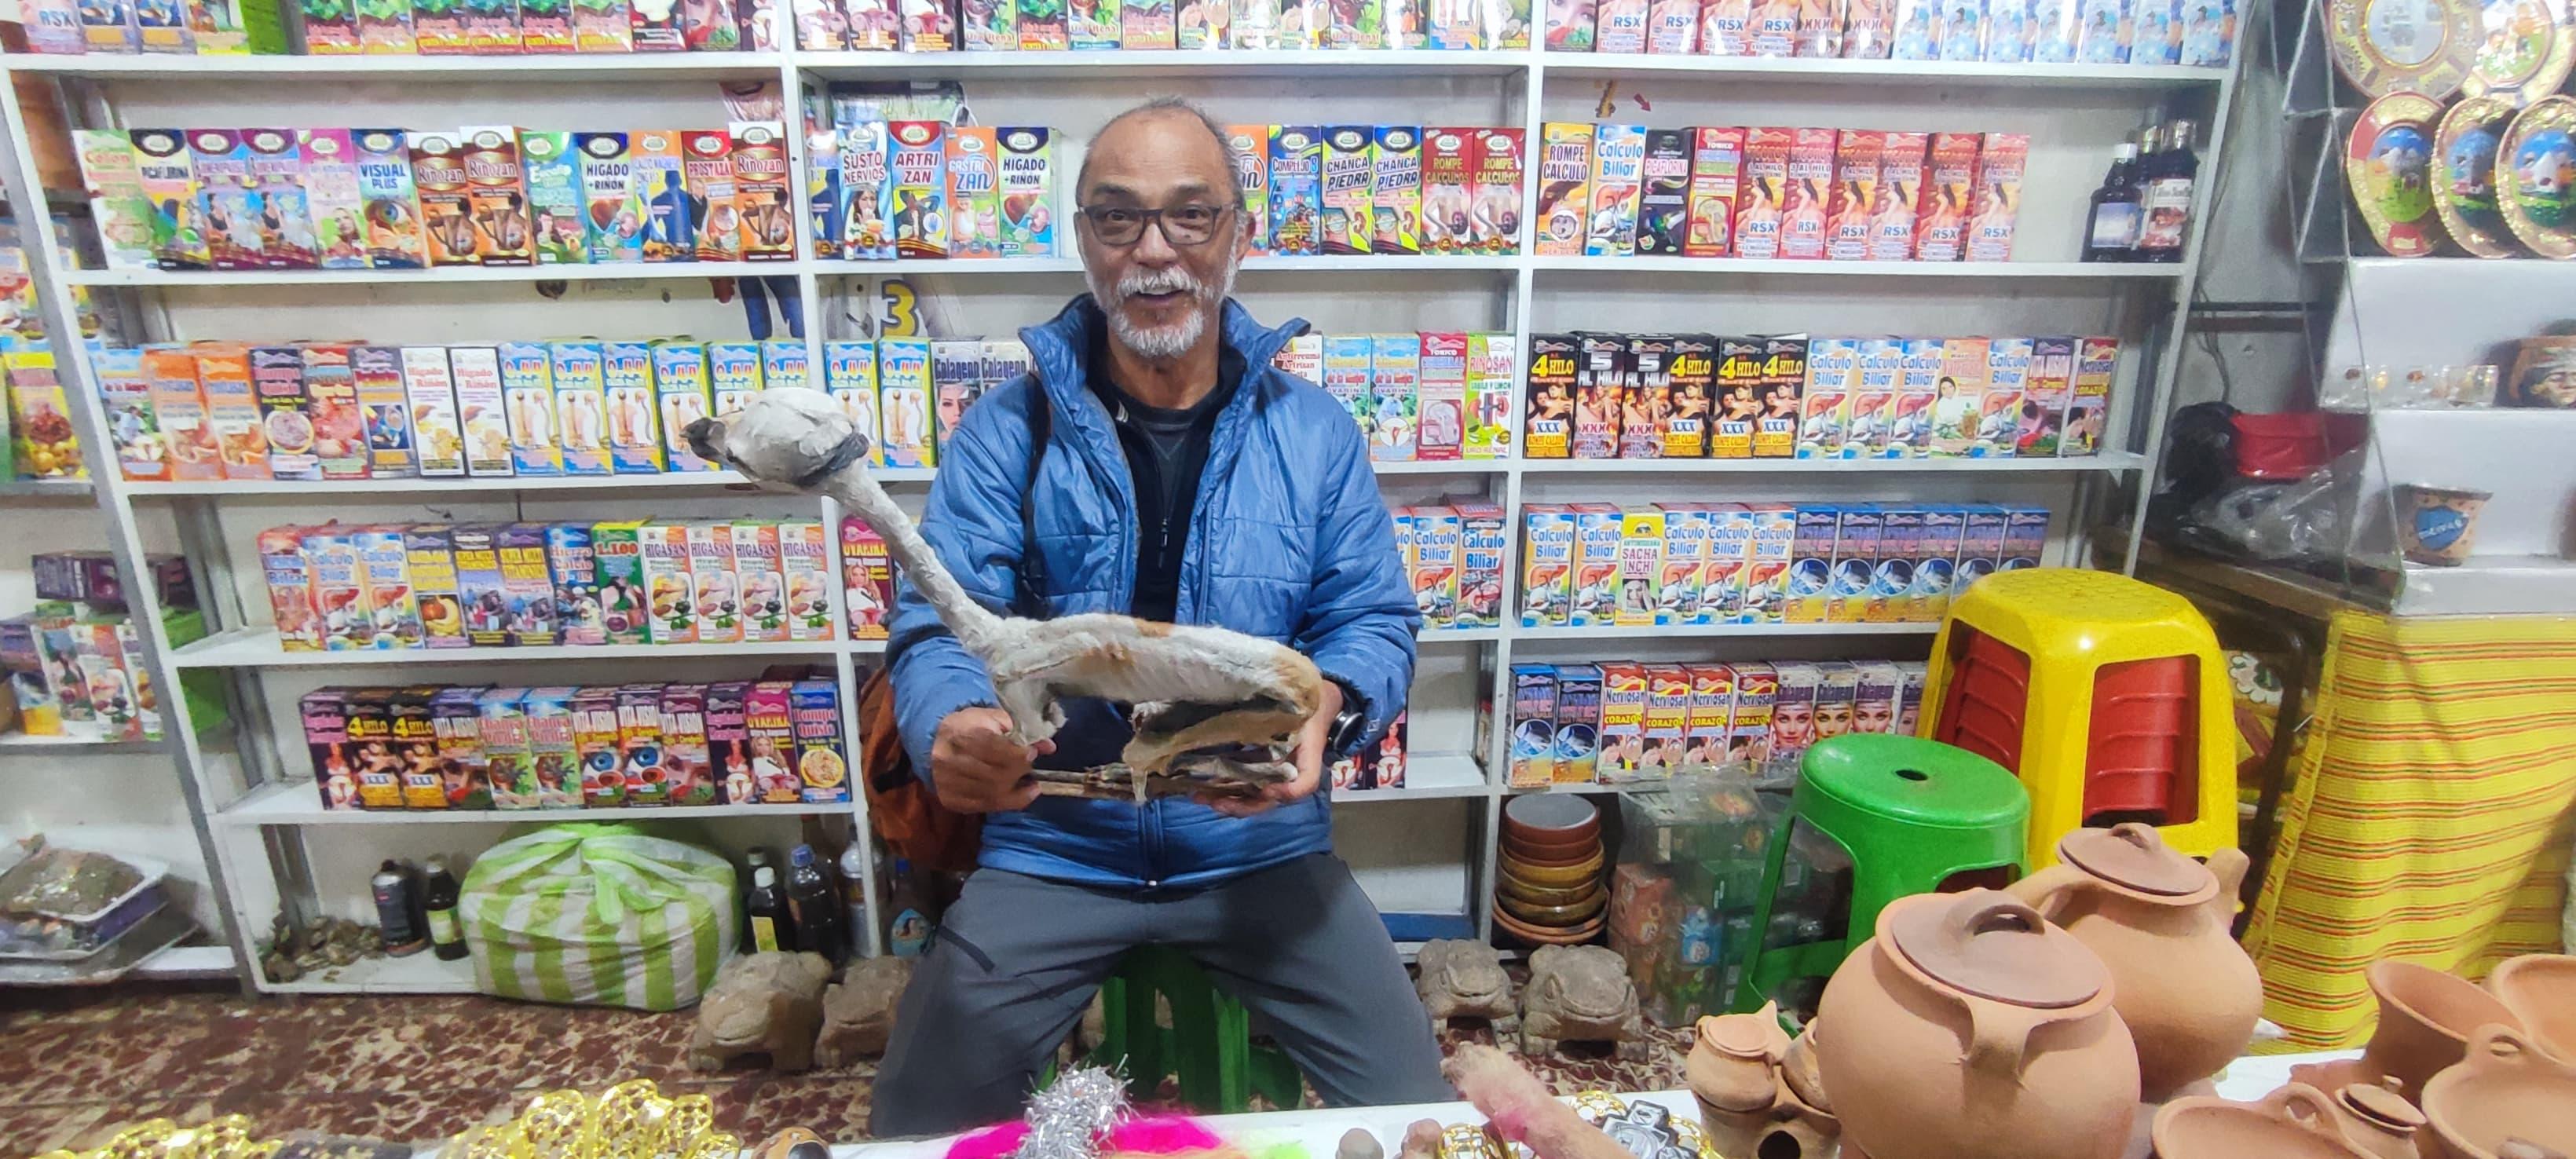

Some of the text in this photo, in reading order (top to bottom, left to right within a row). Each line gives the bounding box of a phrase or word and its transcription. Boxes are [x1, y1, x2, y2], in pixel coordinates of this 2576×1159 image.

[1613, 16, 1641, 27] RSX
[1666, 16, 1691, 27] RSX
[1718, 19, 1744, 31] RSX
[1764, 20, 1791, 31] RSX
[1550, 144, 1585, 161] ROMPE
[1597, 142, 1643, 159] Calculo
[843, 153, 882, 166] SUSTO
[895, 153, 940, 166] ARTRI
[1004, 159, 1045, 171] HIGADO
[1312, 156, 1319, 172] 8
[1327, 158, 1369, 174] CHANCA
[1376, 157, 1417, 173] CHANCA
[1433, 158, 1463, 169] ROMPE
[1484, 158, 1513, 170] ROMPE
[360, 164, 406, 177] VISUAL
[587, 166, 629, 179] HIGADO
[844, 166, 885, 181] NERVIOS
[905, 168, 932, 183] ZAN
[1543, 163, 1587, 181] CALCULO
[1602, 160, 1637, 177] Biliar
[371, 179, 398, 190] PLUS
[1327, 171, 1369, 189] PIEDRA
[1377, 171, 1418, 189] PIEDRA
[1425, 171, 1469, 184] CALCULOS
[1476, 171, 1520, 184] CALCULOS
[1750, 223, 1776, 233] RSX
[1798, 221, 1817, 232] RSX
[1841, 227, 1866, 237] RSX
[1883, 226, 1908, 236] RSX
[1984, 227, 2008, 238] RSX
[1932, 229, 1956, 239] RSX
[880, 280, 920, 338] 3
[1531, 355, 1574, 377] 4 HILO
[1670, 355, 1711, 377] 4 HILO
[1719, 356, 1761, 379] 4 HILO
[1762, 355, 1803, 377] 4 HILO
[1809, 356, 1851, 370] Calculo
[1859, 356, 1899, 370] Calculo
[1901, 356, 1941, 370] Calculo
[1989, 354, 2029, 368] Calculo
[1579, 370, 1623, 386] AL HILO
[1626, 371, 1670, 387] AL HILO
[1814, 372, 1846, 386] Biliar
[1863, 372, 1892, 386] Biliar
[1905, 372, 1935, 386] Biliar
[1992, 371, 2022, 383] Biliar
[1414, 532, 1458, 545] Calculo
[1531, 528, 1572, 542] Calculo
[1580, 528, 1621, 542] Calculo
[1664, 526, 1704, 539] Calculo
[1708, 526, 1749, 539] Calculo
[1751, 527, 1792, 539] Calculo
[1462, 533, 1505, 548] Calculo
[644, 543, 686, 558] HIGASAN
[690, 543, 731, 557] HIGASAN
[735, 544, 776, 558] HIGASAN
[782, 542, 823, 557] HIGASAN
[1420, 547, 1451, 561] Biliar
[1536, 544, 1566, 558] Biliar
[1585, 544, 1615, 557] Biliar
[1622, 548, 1658, 560] SACHA
[1668, 543, 1697, 554] Biliar
[1712, 542, 1742, 554] Biliar
[1756, 542, 1785, 554] Biliar
[1466, 553, 1498, 569] Biliar
[1624, 561, 1655, 572] INCHI
[348, 716, 364, 736] 4
[393, 717, 409, 737] 4
